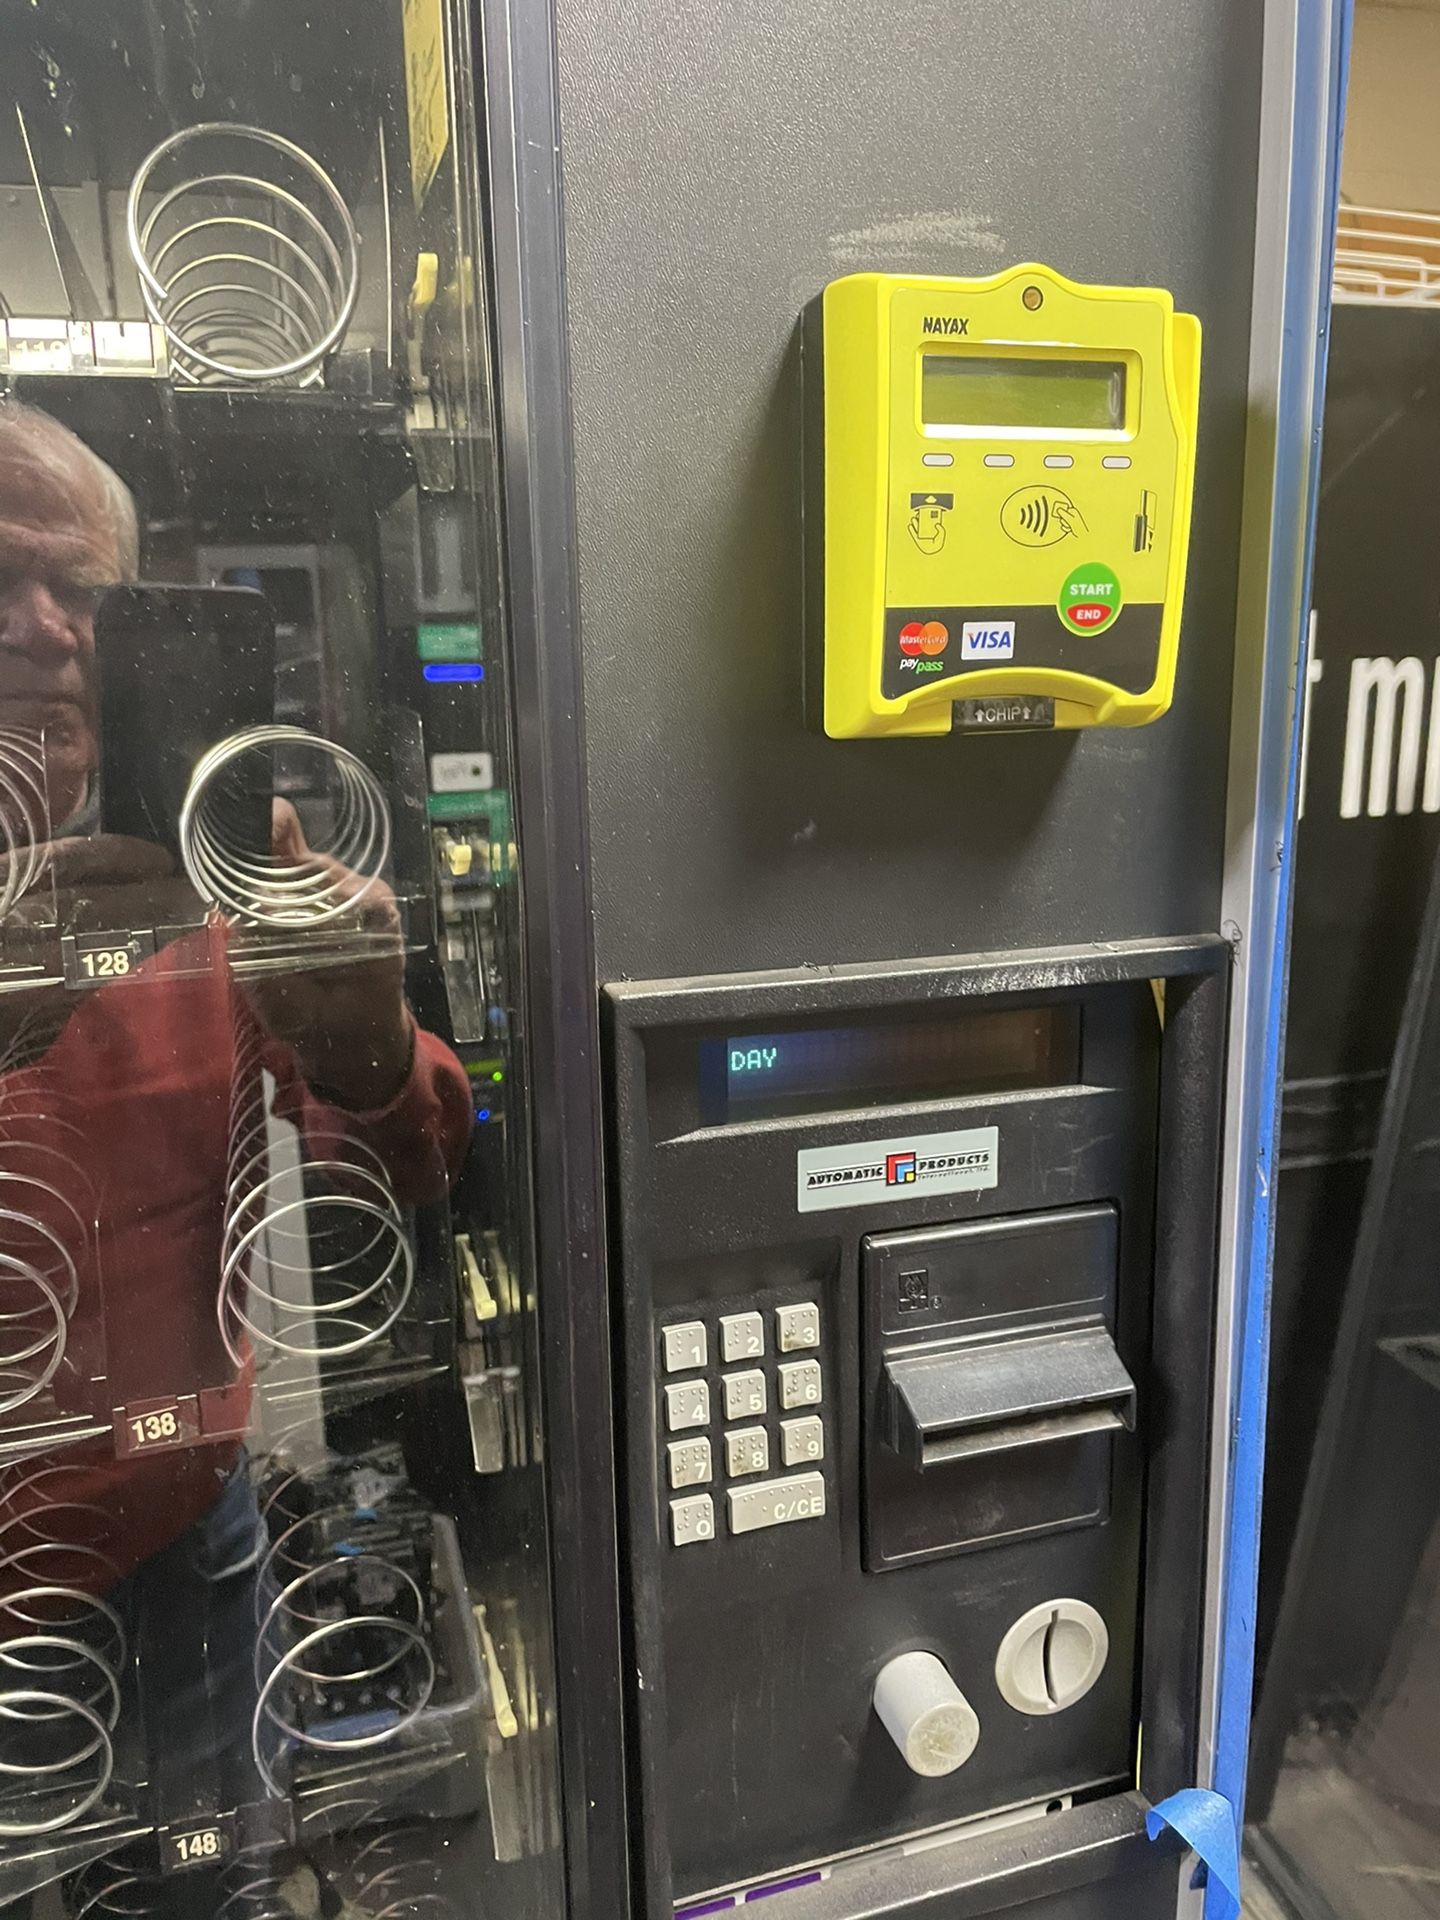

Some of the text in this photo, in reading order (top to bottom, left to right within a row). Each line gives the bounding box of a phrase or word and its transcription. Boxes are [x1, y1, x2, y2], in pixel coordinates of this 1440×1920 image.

[923, 316, 970, 336] NAYAX
[1070, 583, 1114, 596] START
[1076, 609, 1102, 620] END
[968, 631, 1011, 649] VISA
[985, 706, 1022, 722] CHIP
[81, 950, 130, 977] 128
[731, 1047, 777, 1071] DAY
[808, 1153, 990, 1187] AUTOMATIC PRODUCTS
[803, 1326, 816, 1344] 3
[747, 1336, 760, 1354] 2
[691, 1345, 701, 1364] 1
[805, 1383, 818, 1400] 6
[749, 1393, 762, 1411] 5
[691, 1404, 706, 1422] 4
[131, 1412, 177, 1443] 138
[807, 1440, 820, 1457] 9
[752, 1451, 765, 1468] 8
[694, 1461, 708, 1480] 7
[774, 1496, 823, 1520] C/CE
[696, 1519, 711, 1536] 0
[176, 1832, 217, 1860] 148
